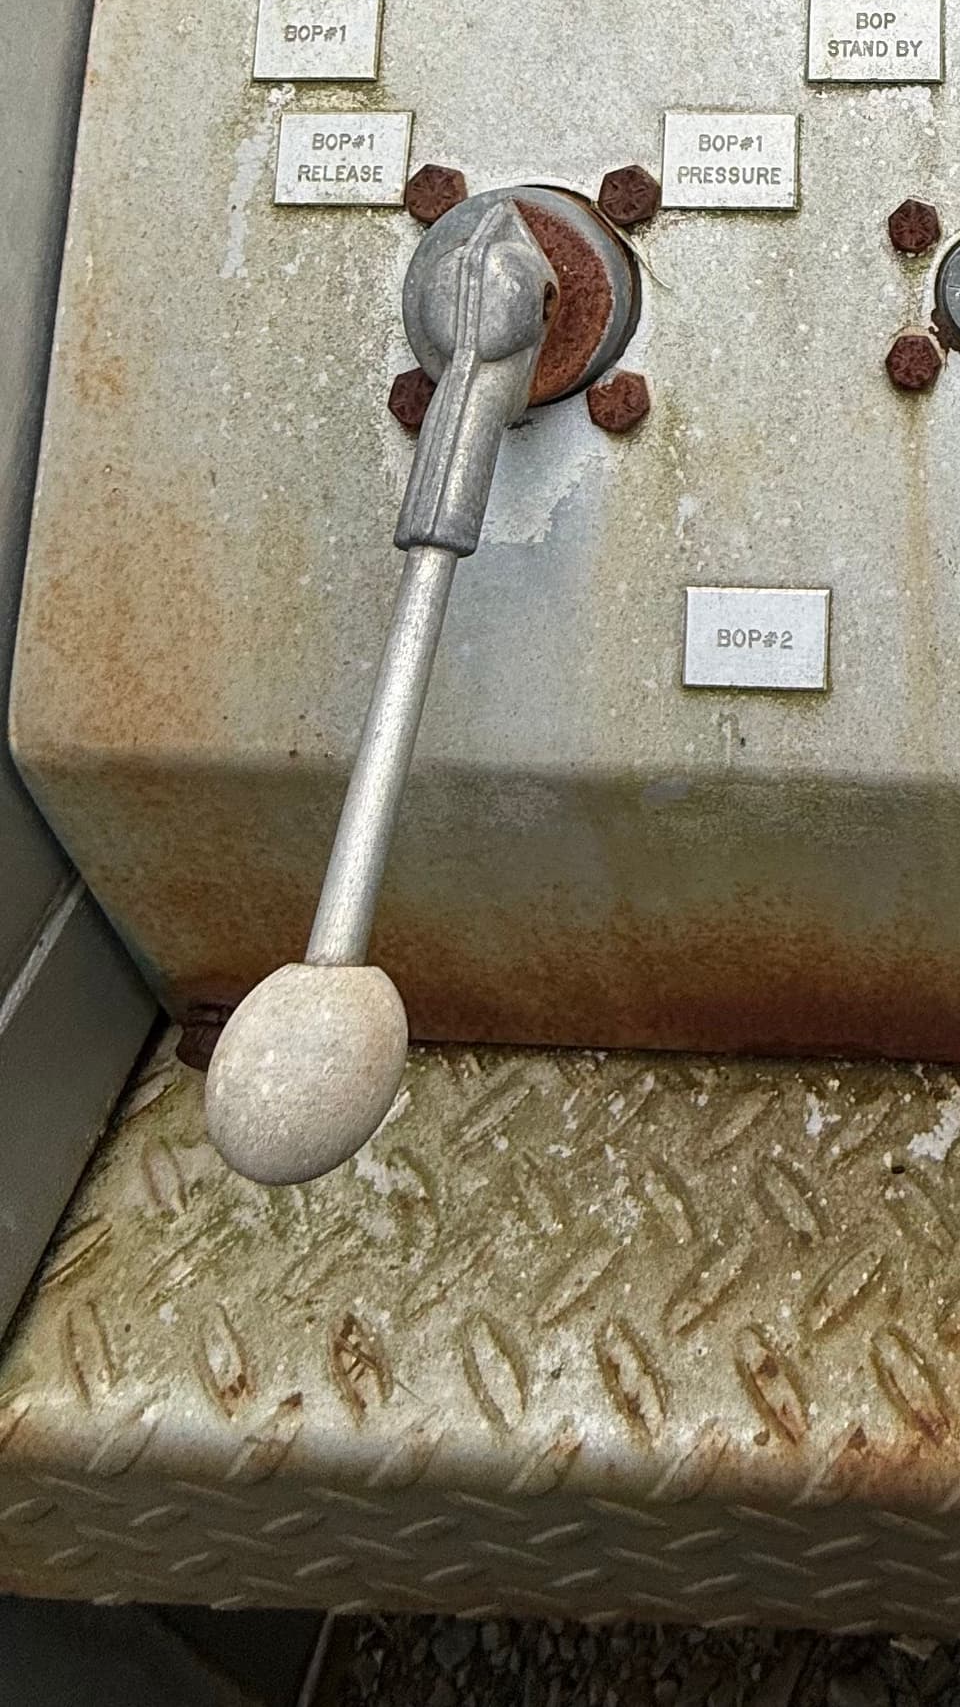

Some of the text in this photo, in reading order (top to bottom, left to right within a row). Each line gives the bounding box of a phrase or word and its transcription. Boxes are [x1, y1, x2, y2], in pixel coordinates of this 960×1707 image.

[856, 12, 896, 30] BOP
[284, 24, 347, 42] BOP#1
[827, 40, 923, 58] STAND BY
[312, 133, 375, 151] BOP#1
[698, 134, 763, 152] BOP#1
[297, 164, 384, 183] RELEASE
[677, 166, 782, 185] PRESSURE
[717, 628, 793, 650] BOP#2
